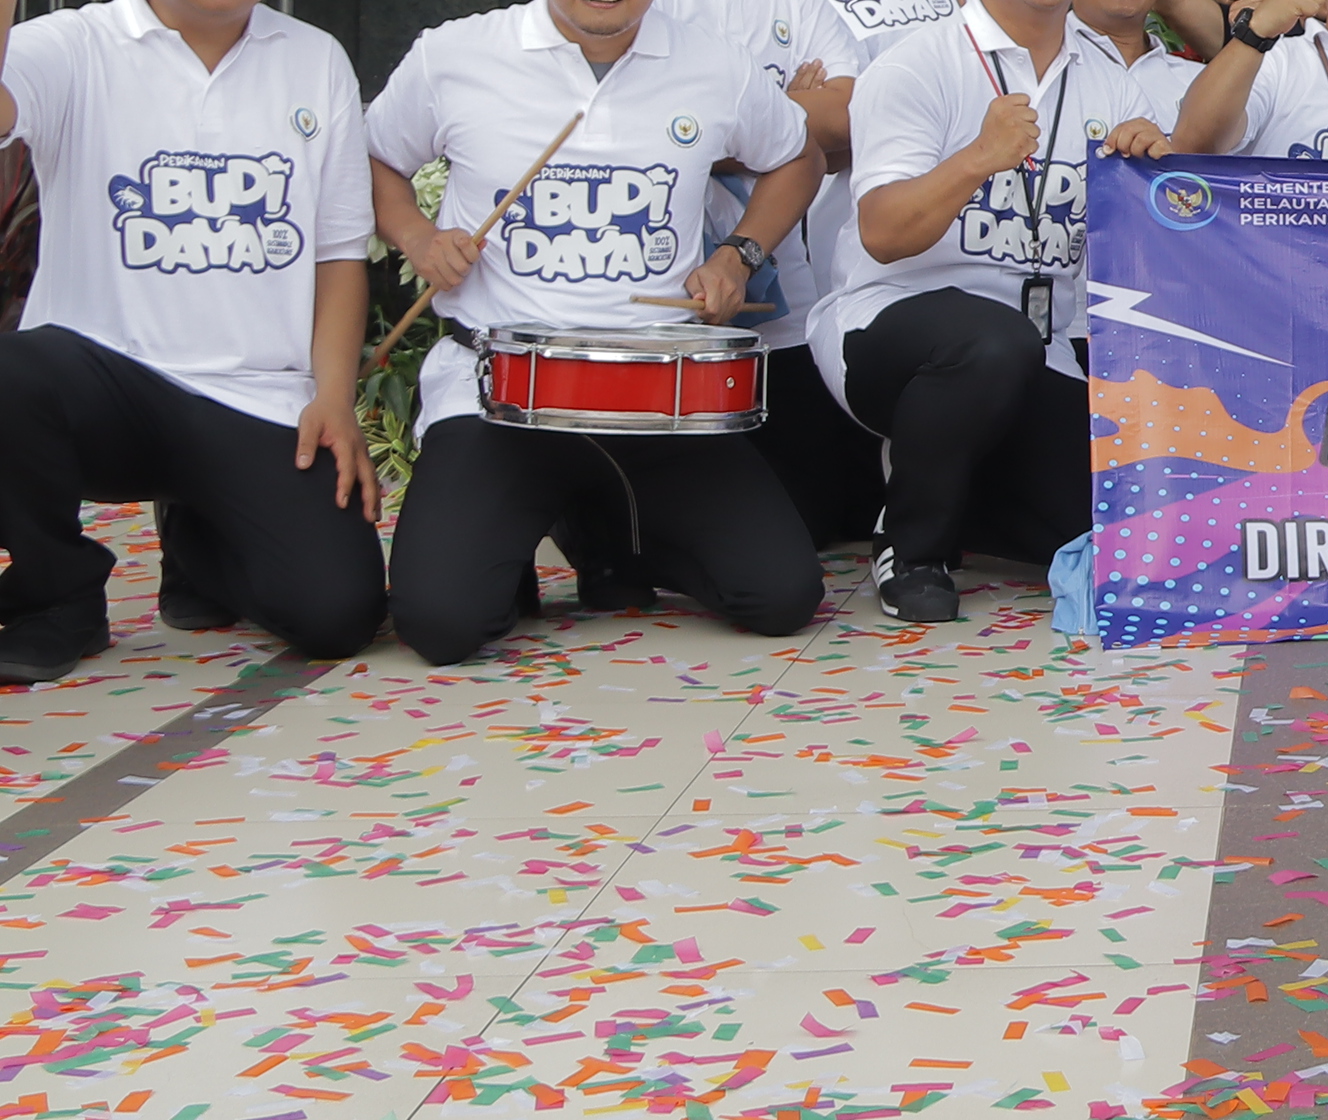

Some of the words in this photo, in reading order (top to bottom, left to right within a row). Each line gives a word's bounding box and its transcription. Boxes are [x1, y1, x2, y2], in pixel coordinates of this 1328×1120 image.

[124, 217, 266, 271] DAYA
[510, 228, 647, 280] DAYA
[964, 209, 1069, 265] DAYA
